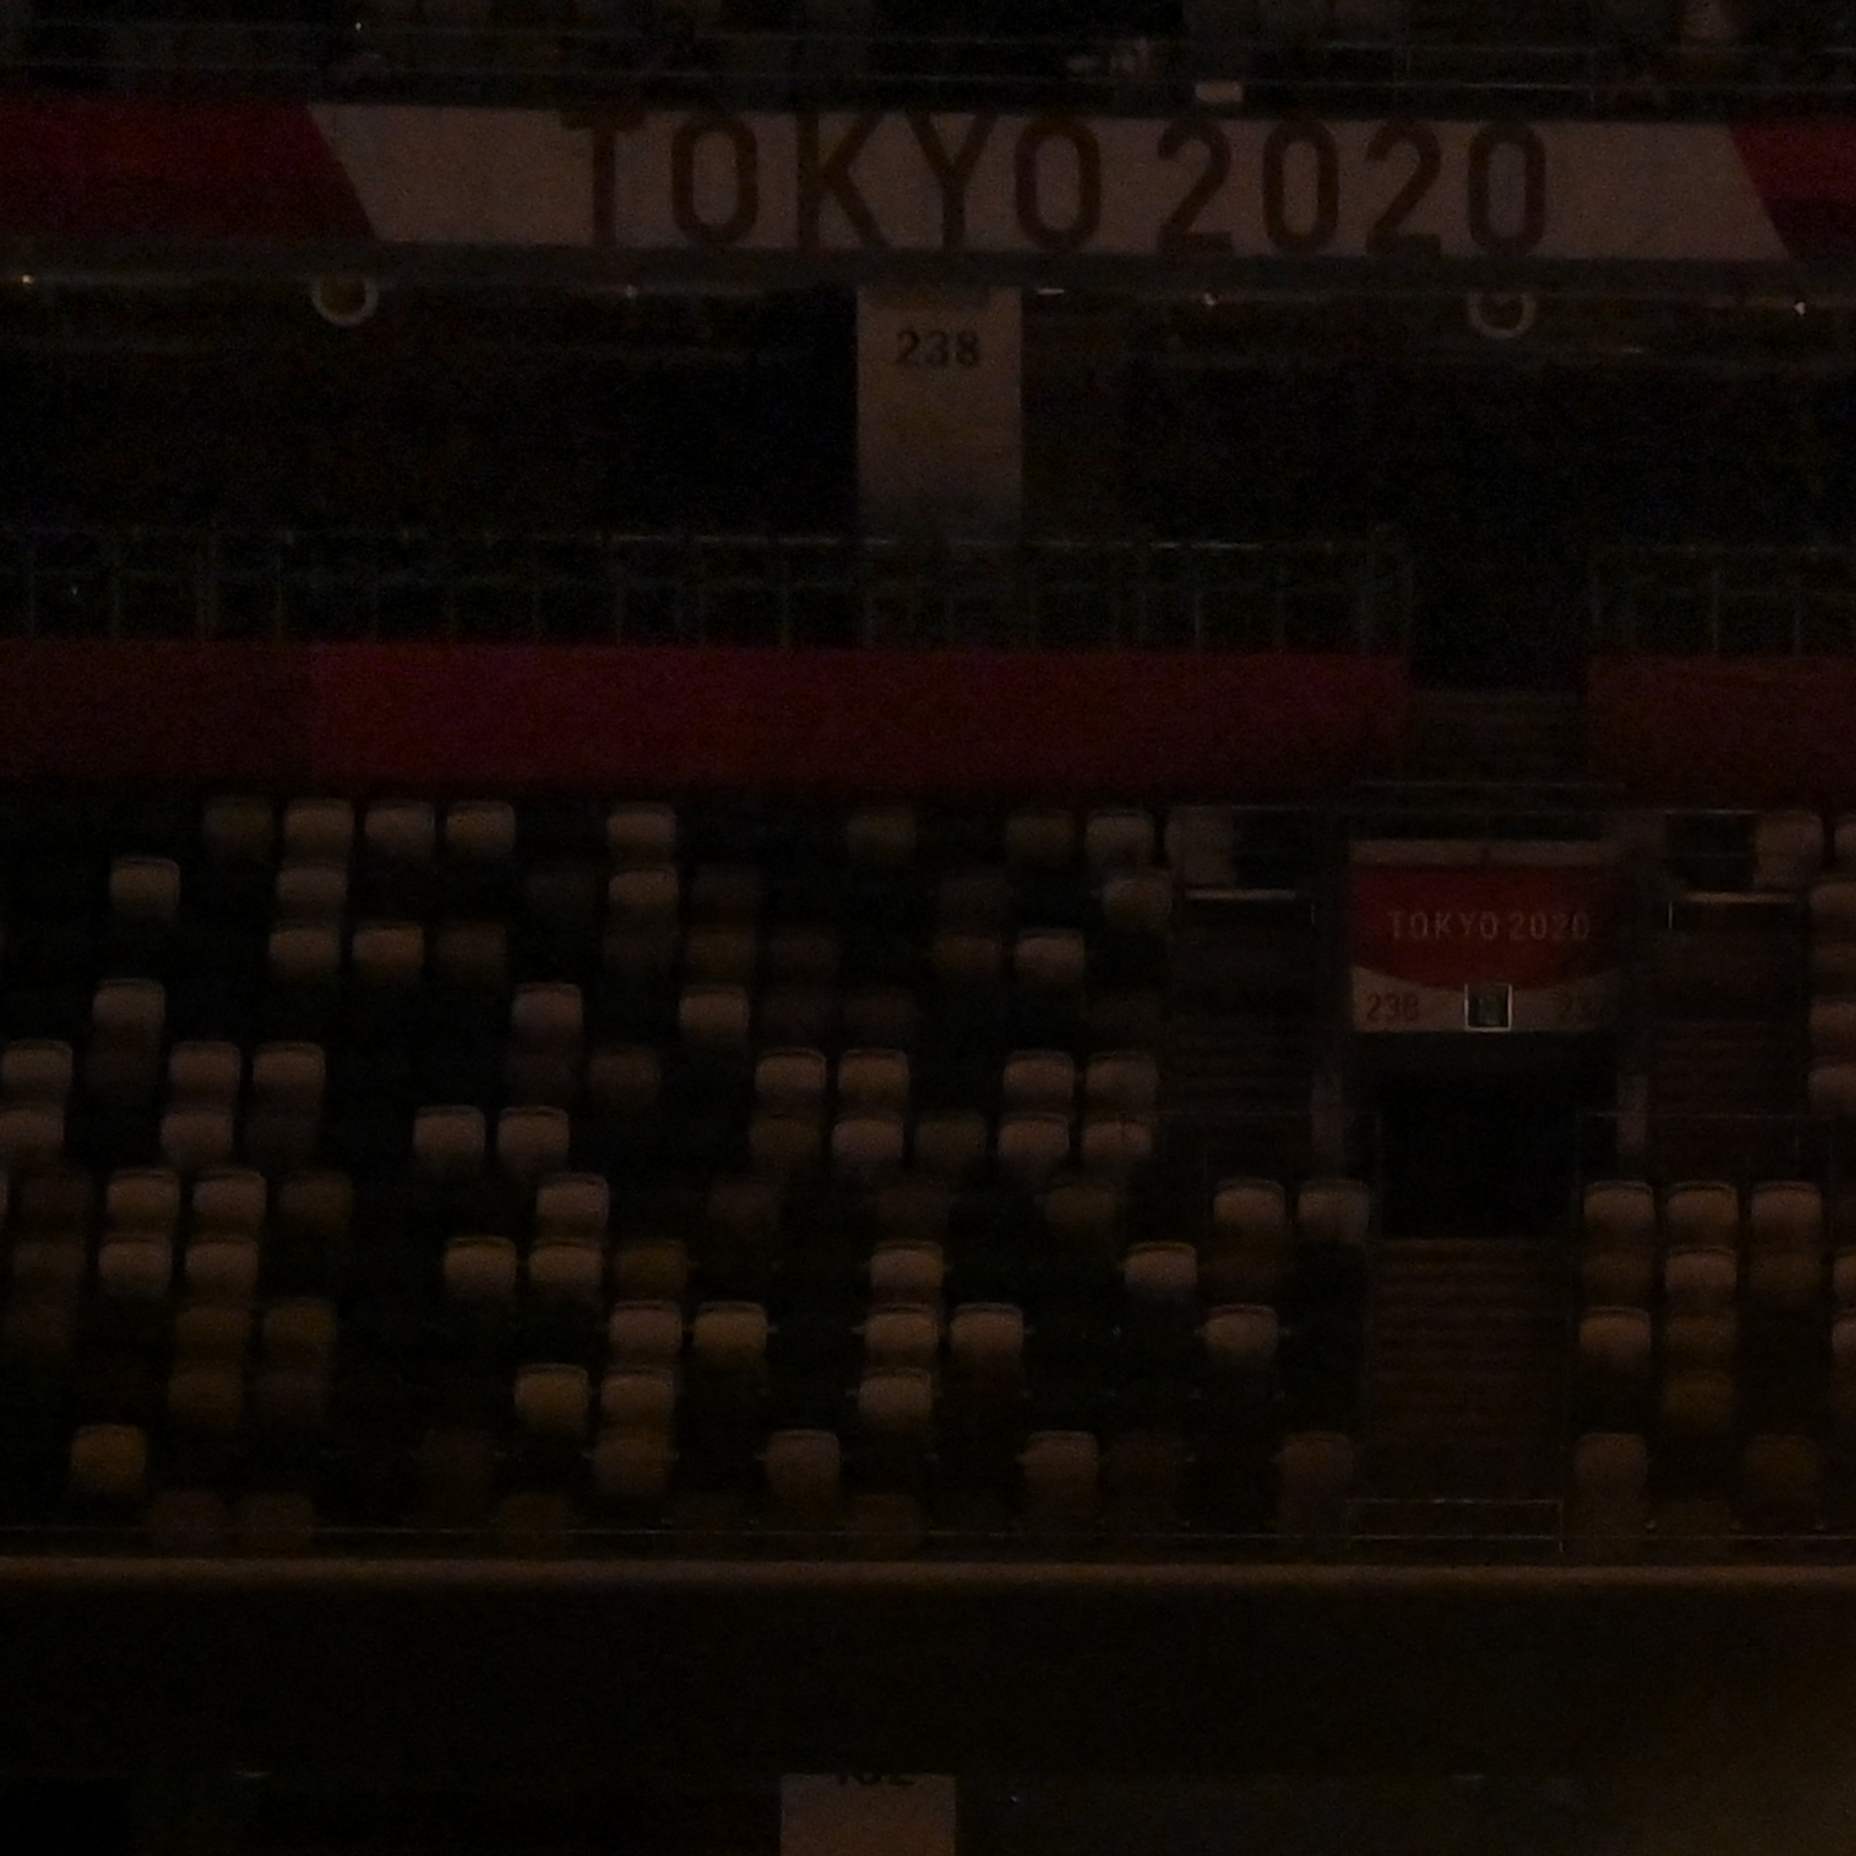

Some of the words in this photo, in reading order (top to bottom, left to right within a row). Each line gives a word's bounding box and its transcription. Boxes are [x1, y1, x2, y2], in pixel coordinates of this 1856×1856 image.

[560, 100, 1100, 254] TOKYO
[1158, 110, 1546, 258] 2020
[897, 329, 981, 369] 238
[1386, 909, 1500, 942] TOKYO
[1507, 909, 1591, 942] 2020
[1366, 992, 1421, 1023] 238
